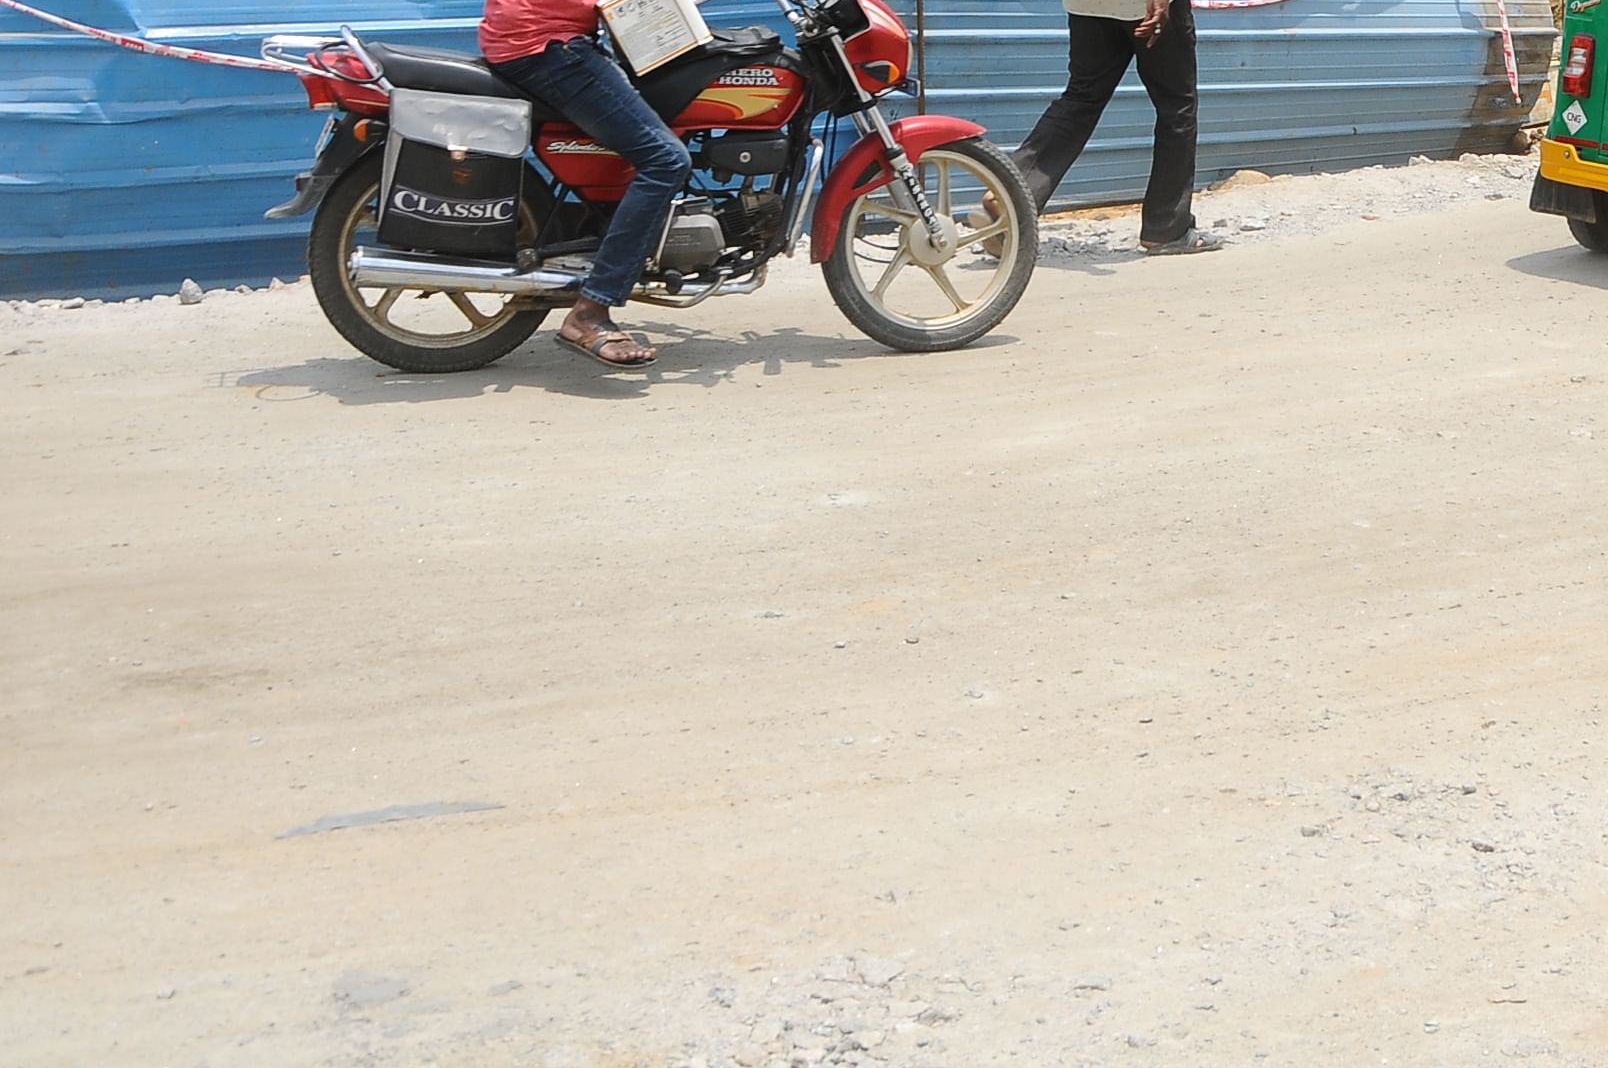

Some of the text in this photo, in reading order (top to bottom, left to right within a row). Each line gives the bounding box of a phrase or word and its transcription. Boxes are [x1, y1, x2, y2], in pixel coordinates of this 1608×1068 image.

[719, 76, 779, 85] HONDA
[1566, 112, 1581, 124] CNG
[394, 190, 514, 220] CLASSIC
